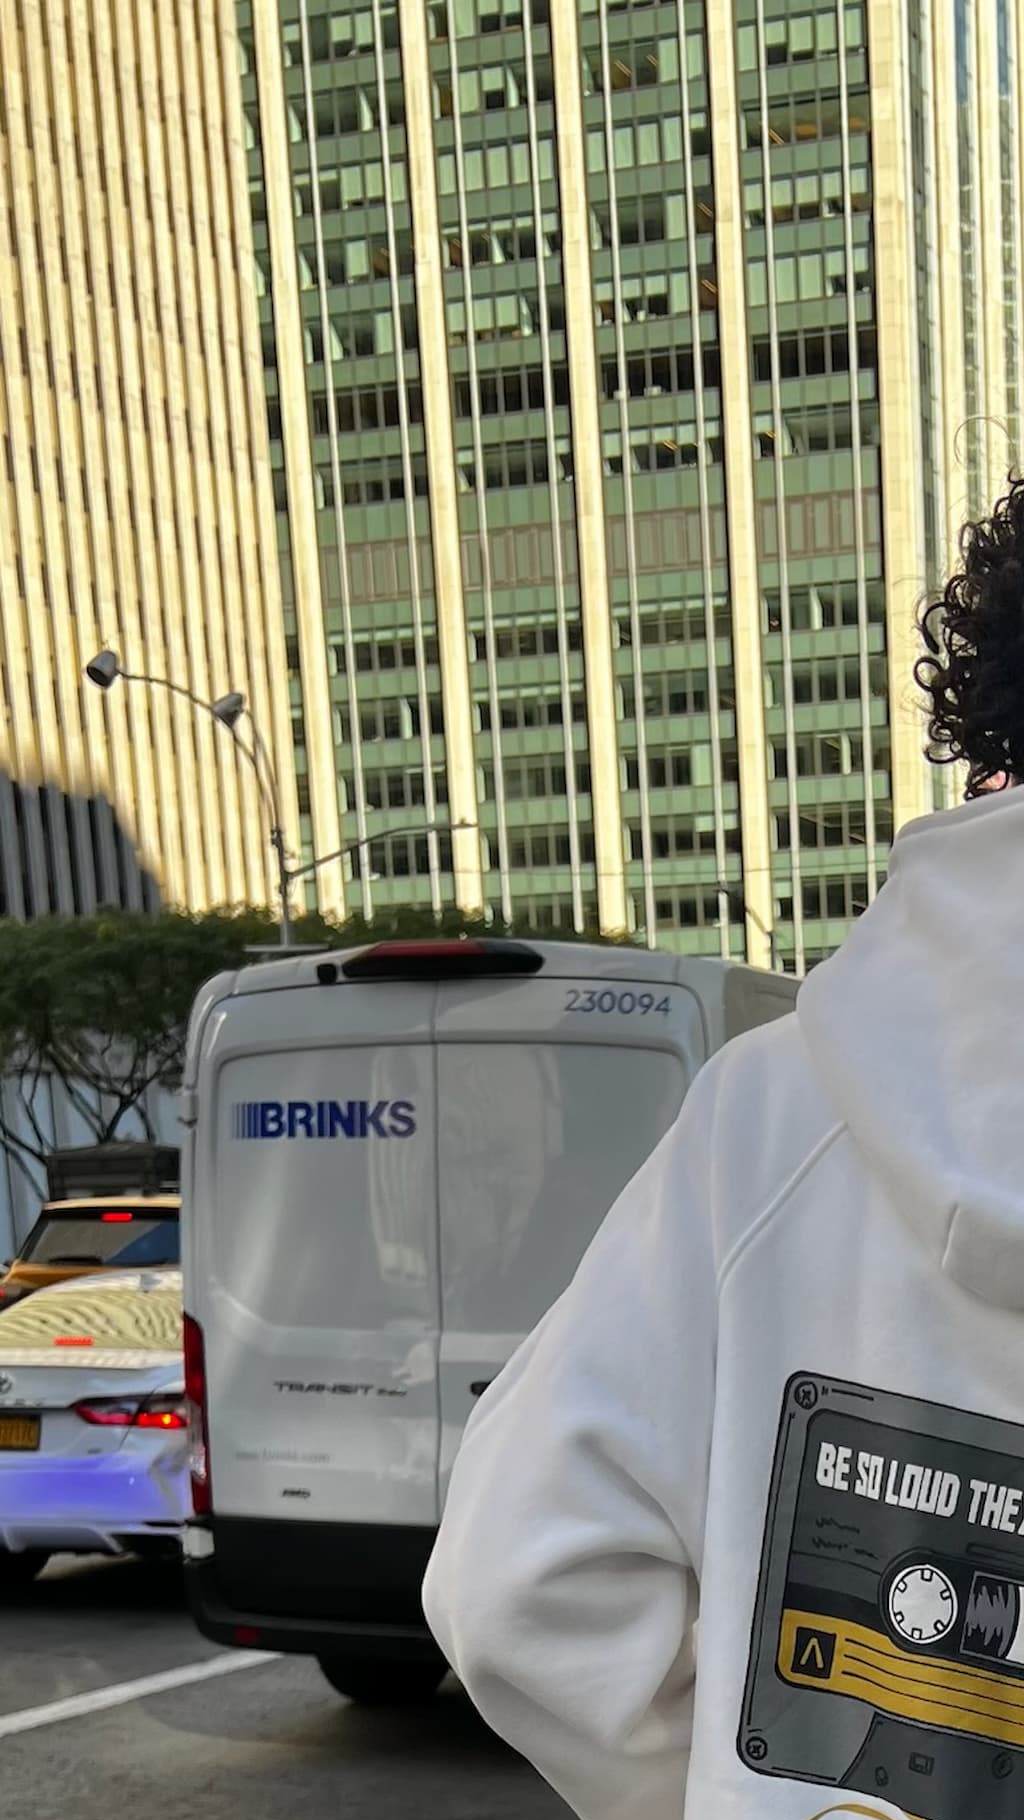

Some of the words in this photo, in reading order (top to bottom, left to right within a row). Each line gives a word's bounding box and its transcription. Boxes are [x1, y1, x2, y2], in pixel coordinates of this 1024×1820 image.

[563, 988, 671, 1016] 230094
[258, 1100, 416, 1139] BRINKS
[273, 1380, 373, 1396] TRANSIT
[815, 1441, 853, 1491] BE
[855, 1451, 884, 1500] SO
[885, 1459, 960, 1519] LOUD
